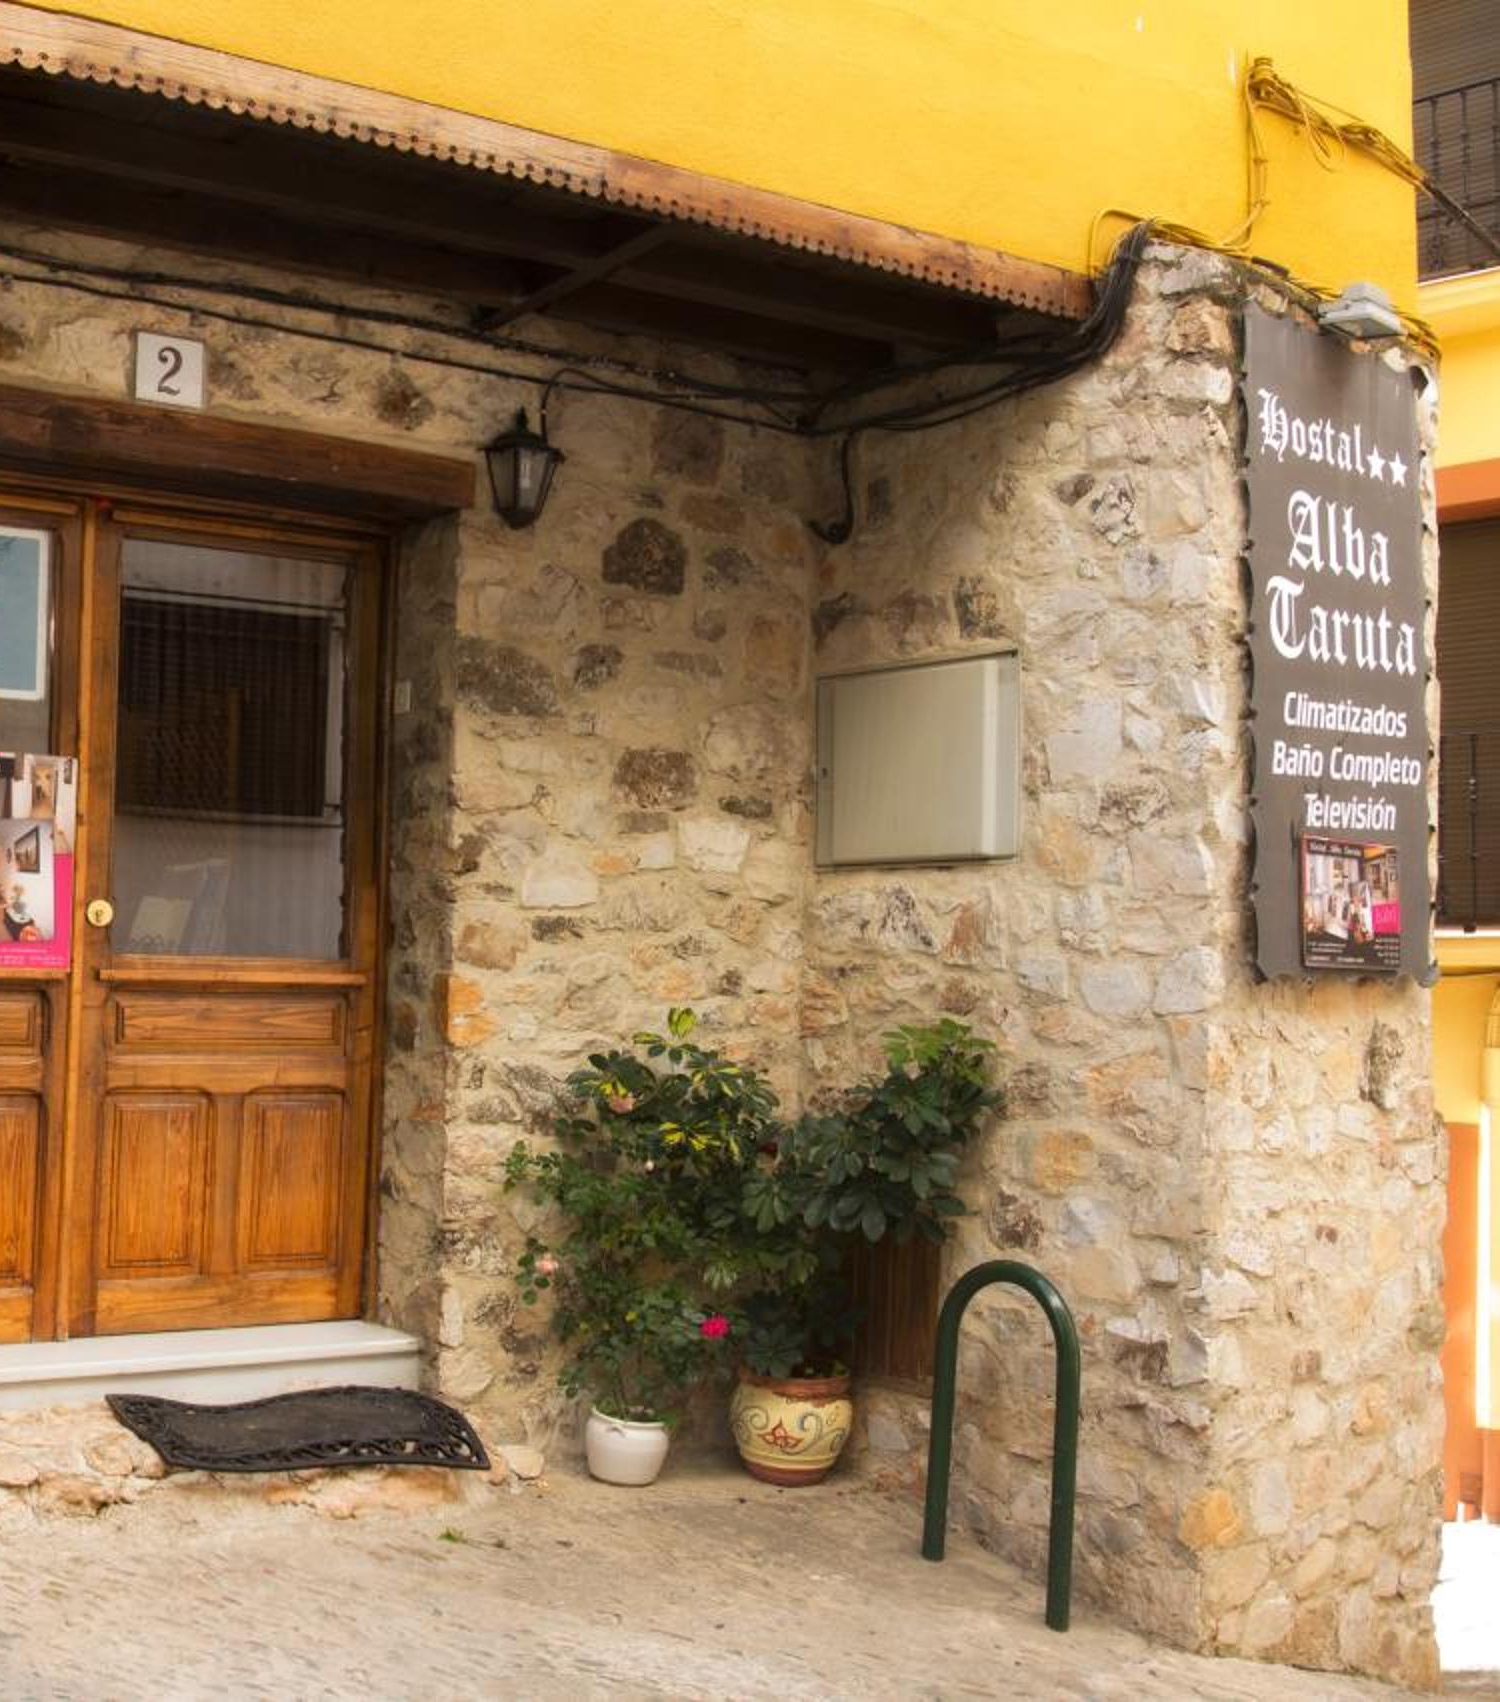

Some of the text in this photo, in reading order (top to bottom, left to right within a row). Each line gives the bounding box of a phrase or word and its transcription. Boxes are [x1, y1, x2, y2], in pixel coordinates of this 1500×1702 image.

[157, 345, 183, 396] 2
[1258, 388, 1365, 475] Hostal
[1288, 489, 1391, 586] Alba
[1265, 575, 1417, 677] Taruta
[1284, 691, 1408, 738] Climatizados
[1273, 740, 1421, 788] Baño Completo
[1304, 793, 1397, 831] Televisión
